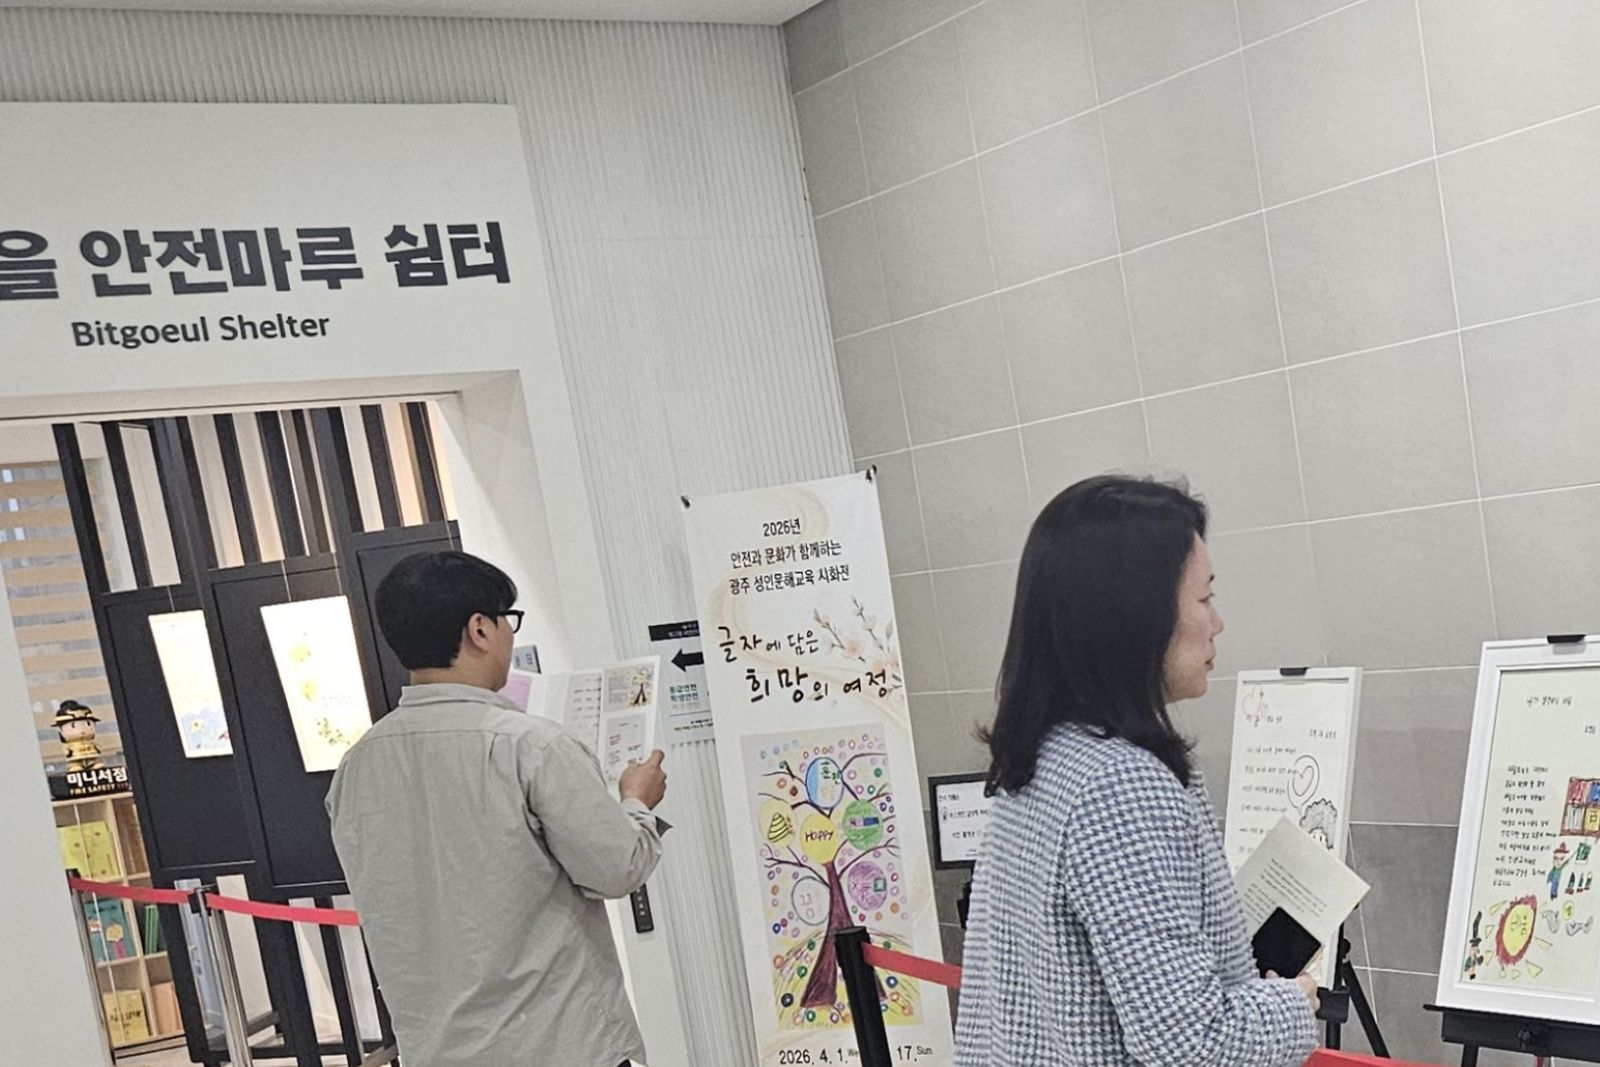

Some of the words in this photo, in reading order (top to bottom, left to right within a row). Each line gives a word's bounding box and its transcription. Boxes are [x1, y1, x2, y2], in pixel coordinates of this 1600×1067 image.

[79, 226, 364, 297] 안전마루
[384, 221, 511, 287] 쉼터
[72, 316, 210, 349] Bitgoeul
[219, 313, 330, 342] Shelter
[763, 518, 801, 537] 2026년
[731, 549, 762, 569] 안전과
[765, 545, 797, 565] 문화가
[799, 540, 842, 560] 함께하는
[729, 577, 751, 596] 광주
[753, 569, 815, 593] 성인문해교육
[817, 564, 850, 583] 시화전
[718, 626, 782, 663] 글자에
[788, 630, 819, 655] 담은
[745, 667, 829, 703] 희망의
[843, 669, 888, 698] 여정
[67, 767, 127, 787] 미니서점
[779, 1049, 815, 1066] 2026.
